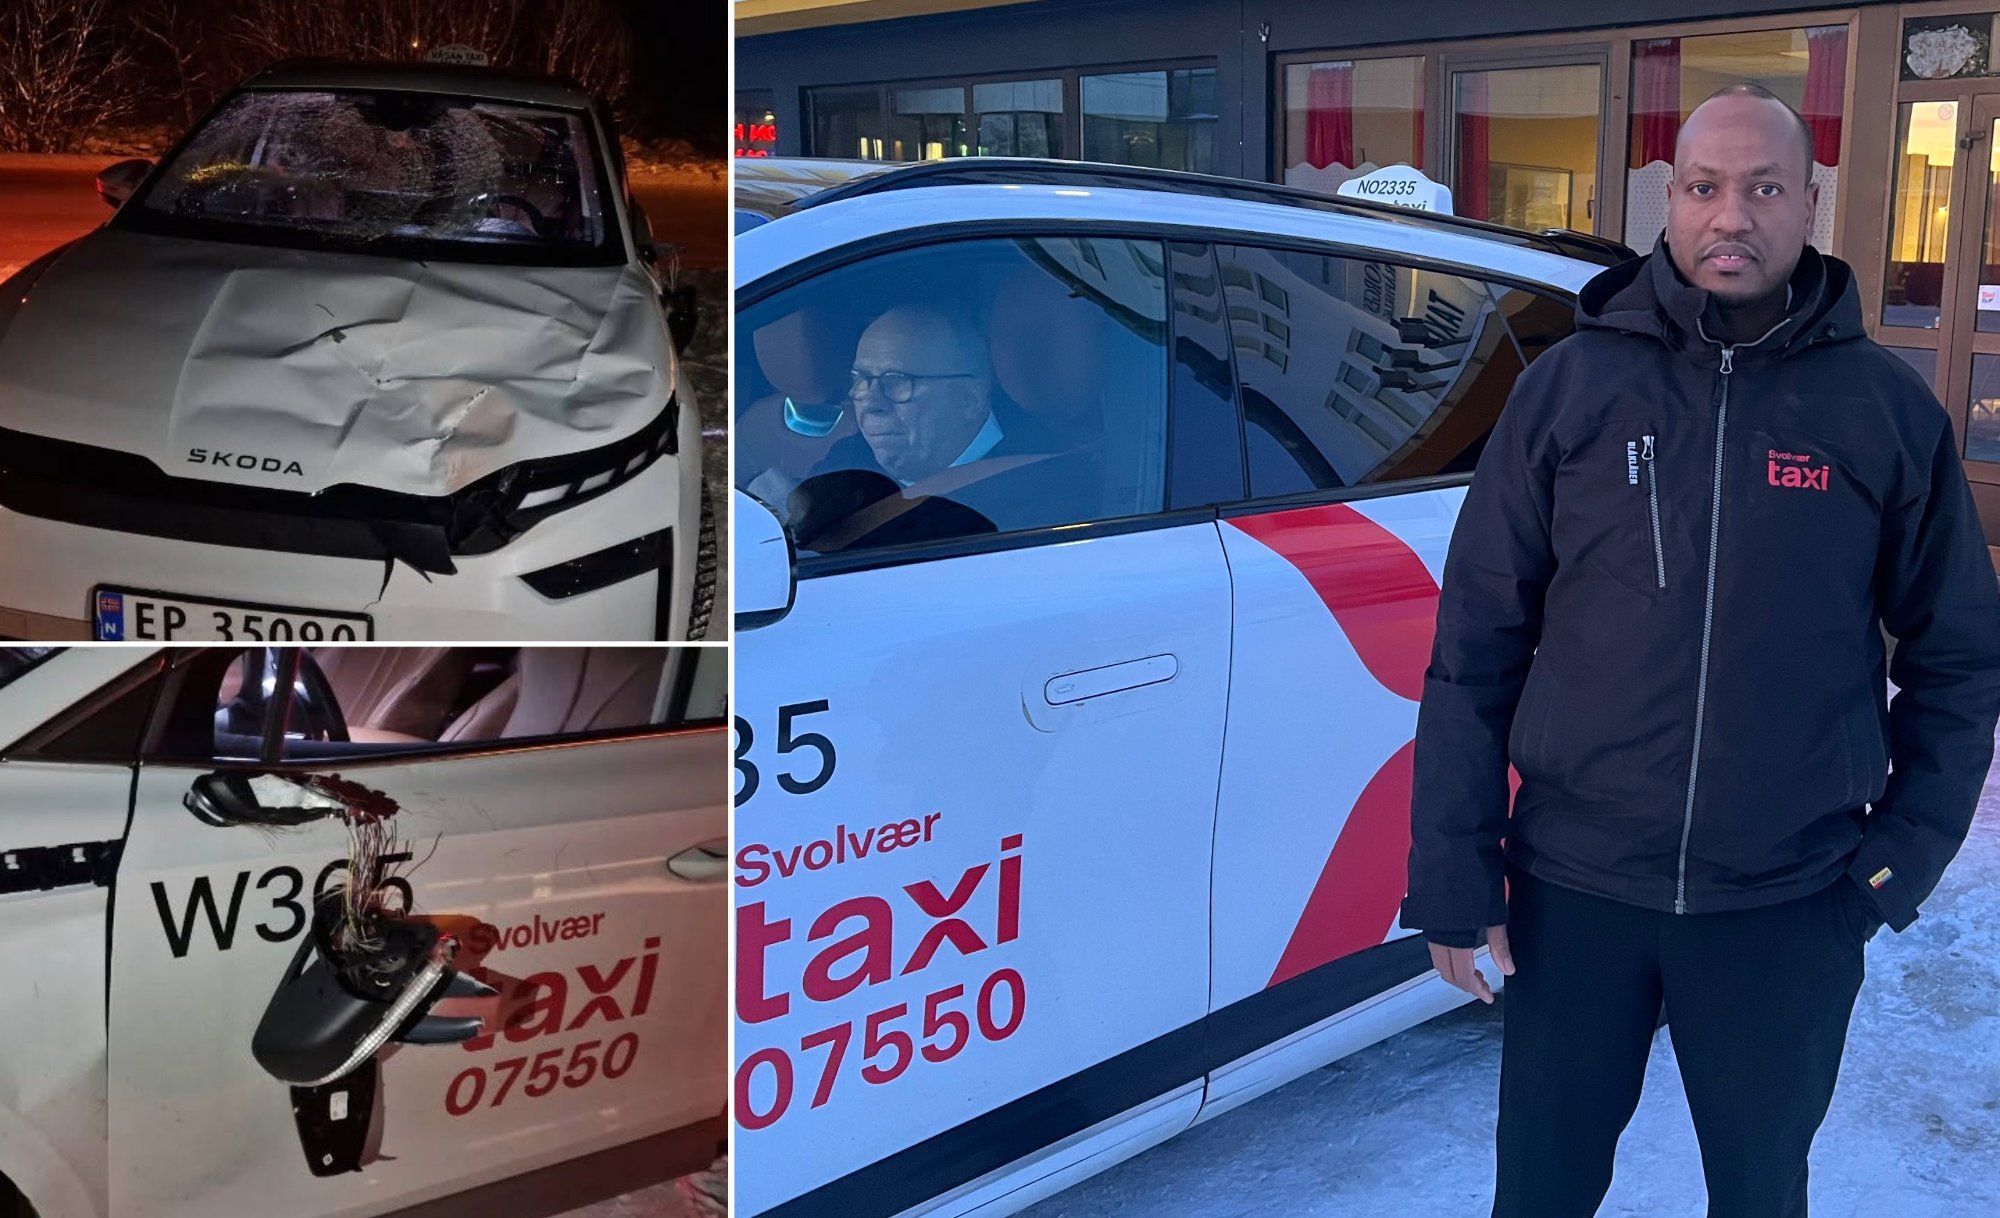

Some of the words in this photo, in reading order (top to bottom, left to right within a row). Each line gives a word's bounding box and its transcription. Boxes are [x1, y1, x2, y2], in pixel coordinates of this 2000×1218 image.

[1357, 180, 1417, 195] NO2335
[1768, 460, 1829, 491] taxi
[135, 602, 187, 641] EP
[734, 698, 837, 808] 35
[734, 811, 941, 888] Svolvær
[469, 913, 605, 955] Svolvær
[735, 833, 1023, 1024] taxi
[445, 1032, 640, 1116] 07550
[734, 967, 1026, 1131] 07550
